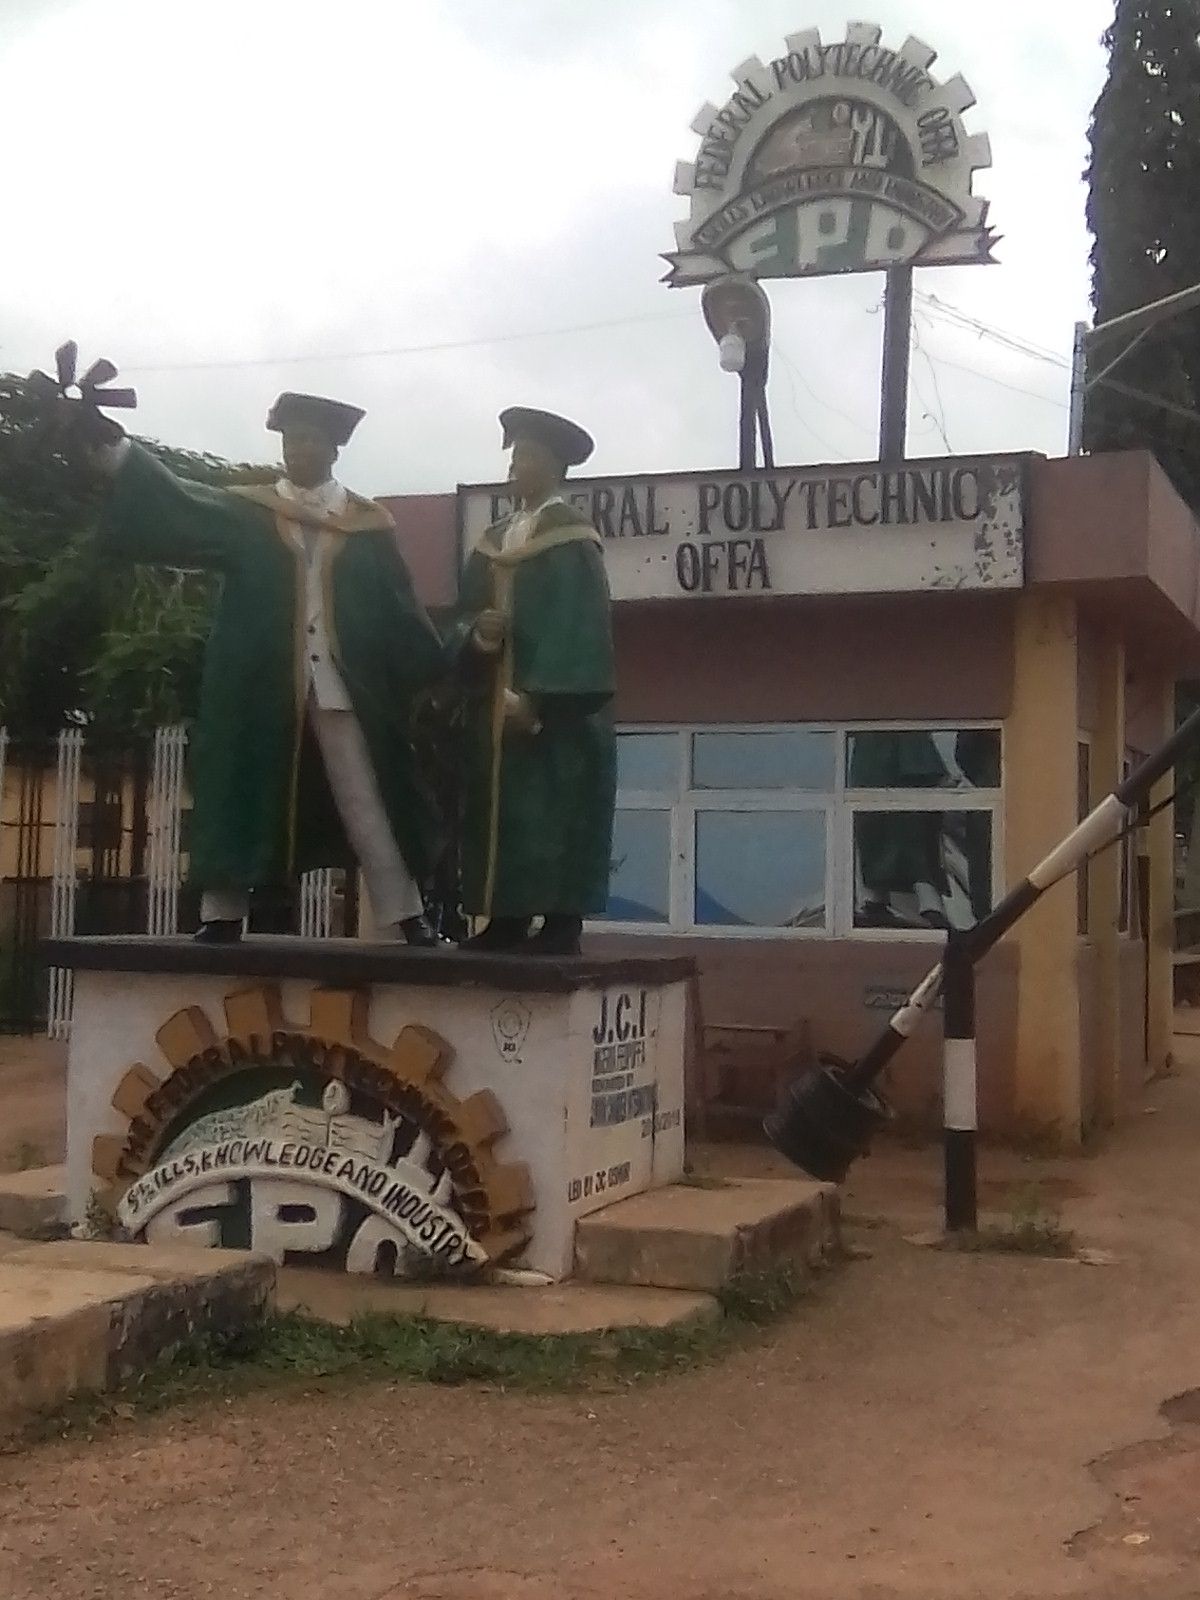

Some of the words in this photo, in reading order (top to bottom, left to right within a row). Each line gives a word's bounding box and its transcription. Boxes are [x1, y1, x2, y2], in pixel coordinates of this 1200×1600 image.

[694, 78, 773, 191] FEDERAL
[769, 43, 935, 107] POLYTECHNIC
[490, 485, 670, 538] FRAL
[698, 467, 985, 534] POLYTECHNIC
[676, 538, 772, 592] OFFA
